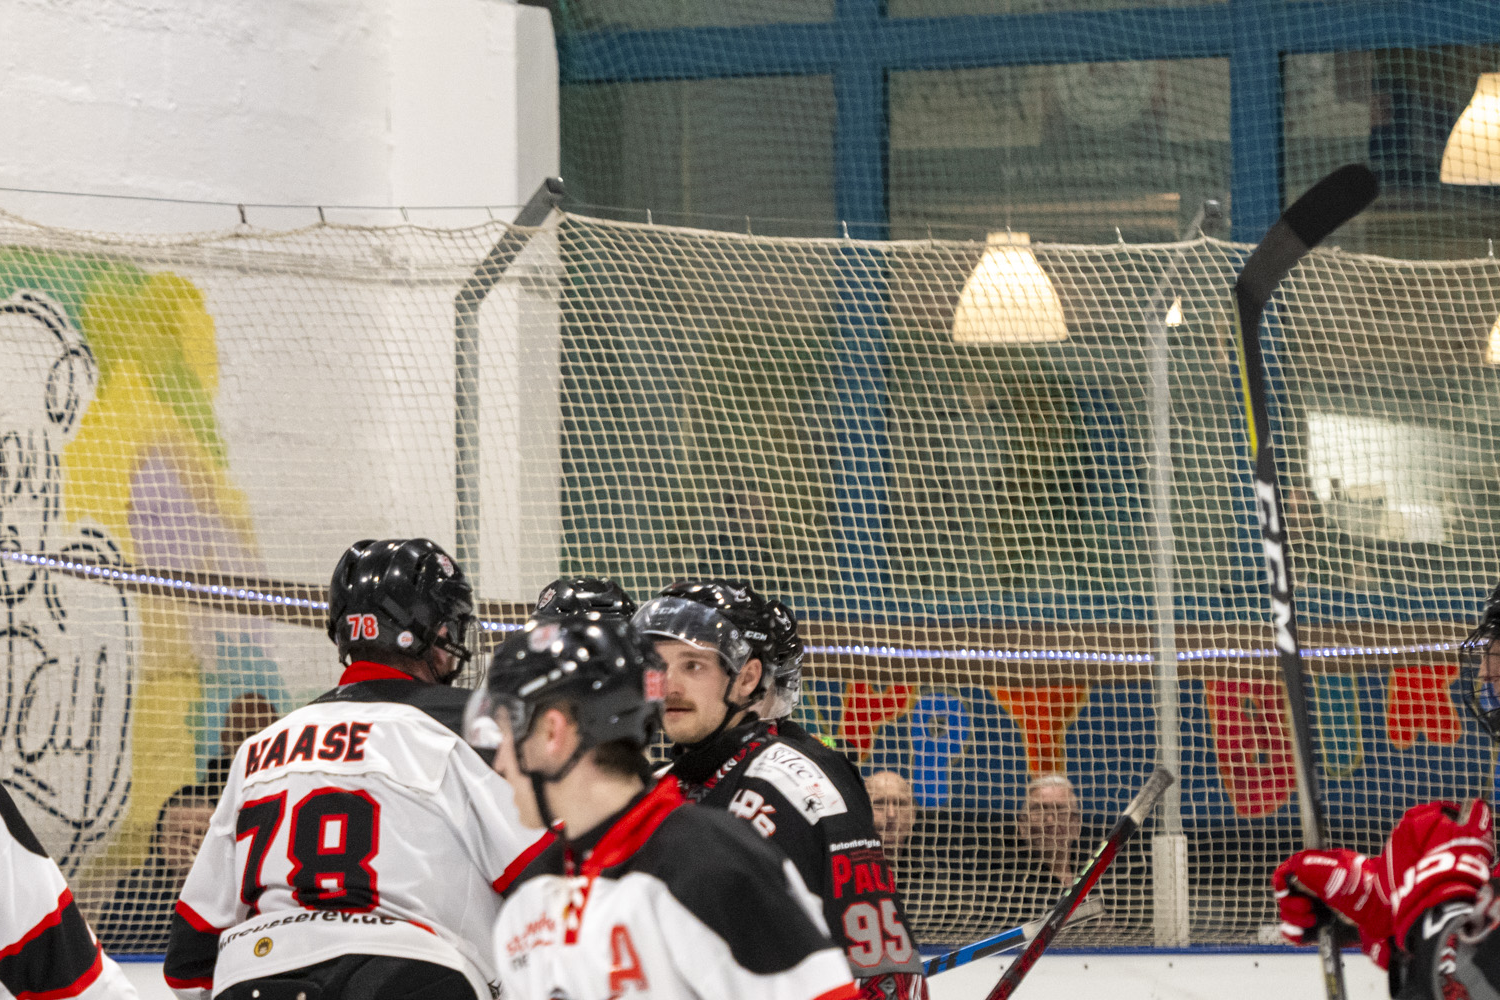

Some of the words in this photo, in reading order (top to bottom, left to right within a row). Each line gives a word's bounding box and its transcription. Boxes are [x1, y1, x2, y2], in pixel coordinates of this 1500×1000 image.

[347, 614, 379, 640] 78
[745, 631, 767, 641] CCM
[245, 722, 374, 780] HAASE
[235, 786, 381, 918] 78
[609, 924, 649, 992] A
[842, 898, 913, 968] 95
